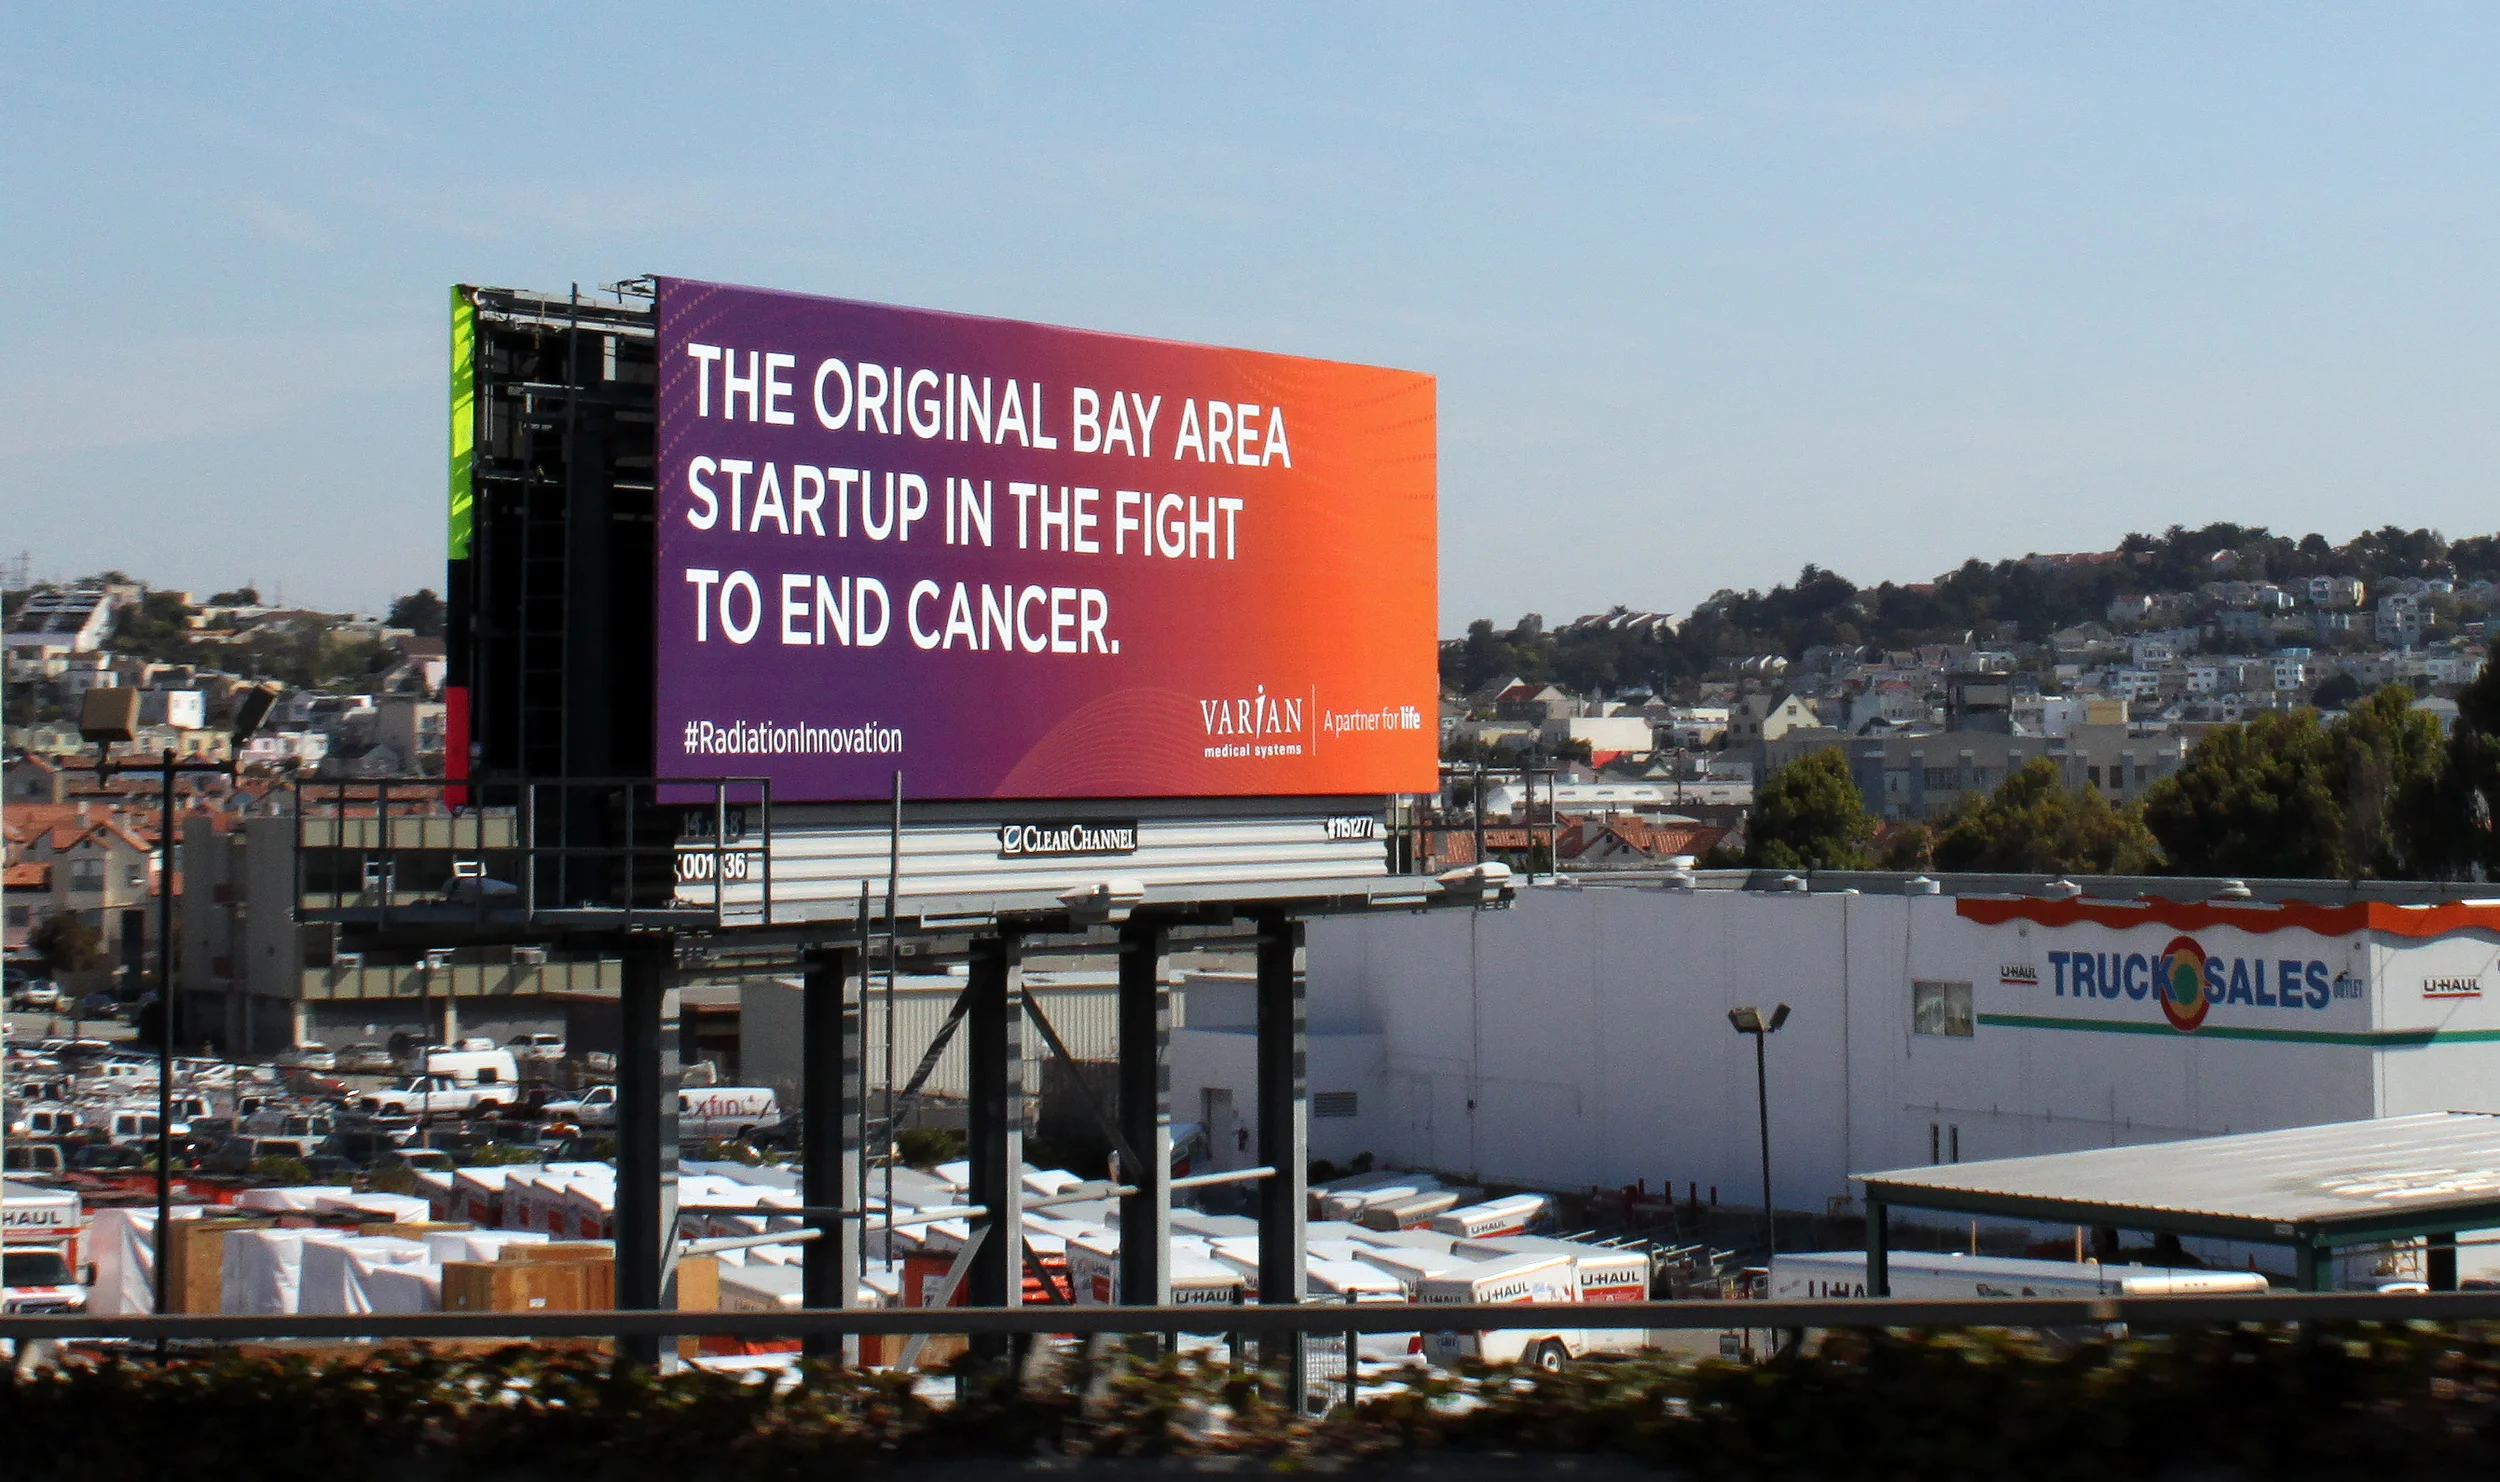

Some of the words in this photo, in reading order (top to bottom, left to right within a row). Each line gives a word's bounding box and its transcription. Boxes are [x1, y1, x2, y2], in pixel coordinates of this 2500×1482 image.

[687, 343, 796, 426] THE
[813, 357, 1058, 450] ORIGINAL
[1072, 386, 1161, 458] BAY
[1174, 397, 1292, 469] AREA
[686, 455, 929, 542] STARTUP
[945, 477, 992, 547] IN
[1008, 482, 1100, 554] THE
[1115, 490, 1244, 560] FIGHT
[685, 568, 762, 645] TO
[781, 573, 891, 647] END
[907, 579, 1120, 655] CANCER.
[684, 719, 902, 754] #RadiationInnovation
[1323, 709, 1333, 731] A
[1335, 709, 1380, 738] partner
[1382, 706, 1399, 729] for
[1400, 706, 1420, 729] life
[1204, 743, 1250, 758] medical
[1254, 743, 1302, 758] systems
[2048, 951, 2177, 1002] TRUCK
[2203, 956, 2330, 1010] SALES
[2423, 978, 2480, 991] U-HAUL
[1471, 1221, 1506, 1234] U-HAUL
[1479, 1281, 1529, 1302] U-HAUL
[1580, 1271, 1640, 1286] U-HAUL
